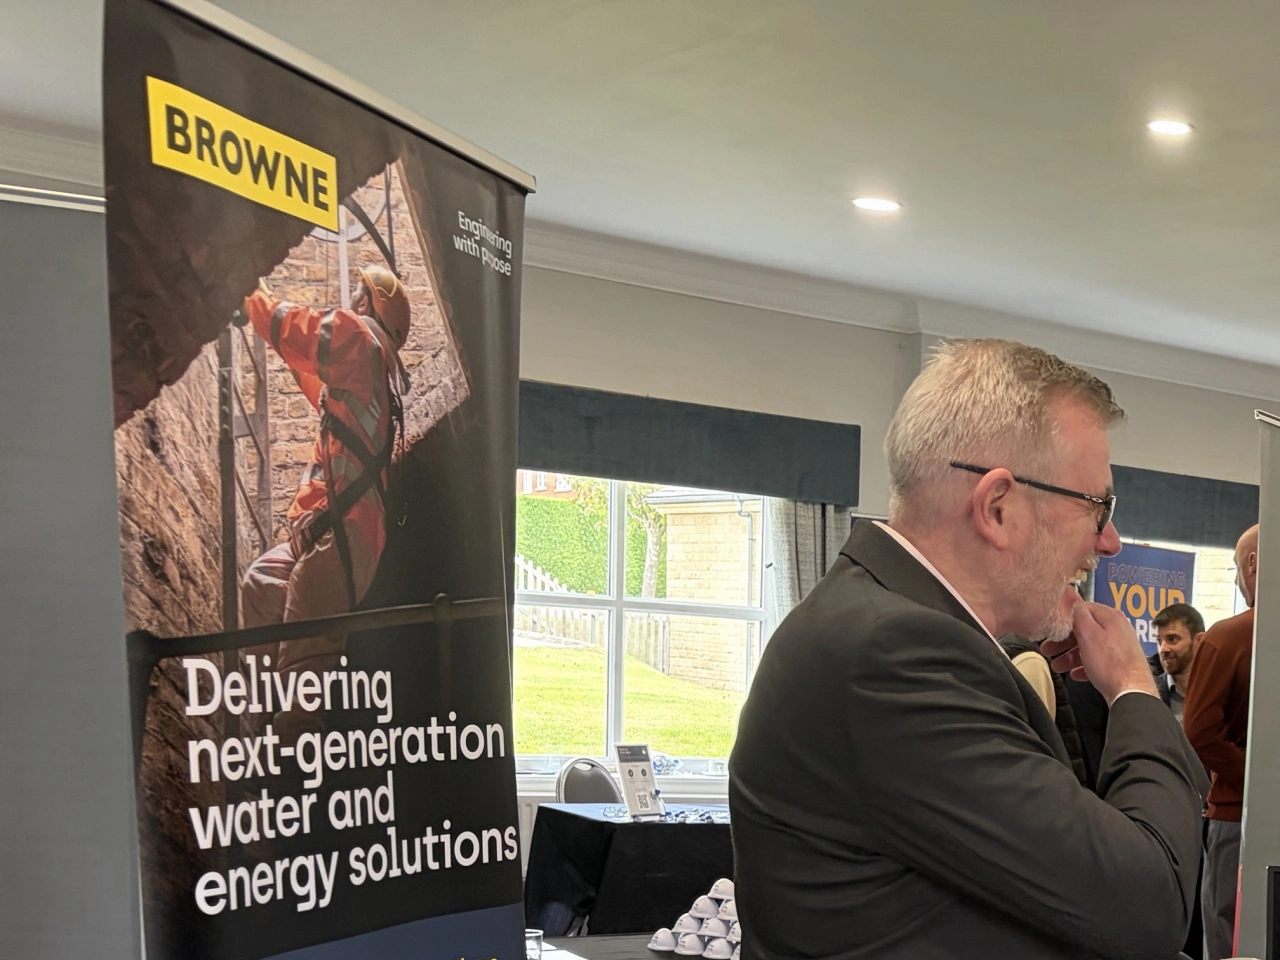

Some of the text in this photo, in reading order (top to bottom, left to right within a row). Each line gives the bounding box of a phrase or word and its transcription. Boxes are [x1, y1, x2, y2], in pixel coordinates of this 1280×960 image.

[165, 104, 330, 212] BROWNE
[453, 234, 511, 276] with pose
[1108, 563, 1186, 590] POWERING
[183, 655, 393, 724] Delivering
[188, 711, 505, 789] next-generation
[189, 770, 395, 850] water and
[195, 820, 518, 915] energy solutions
